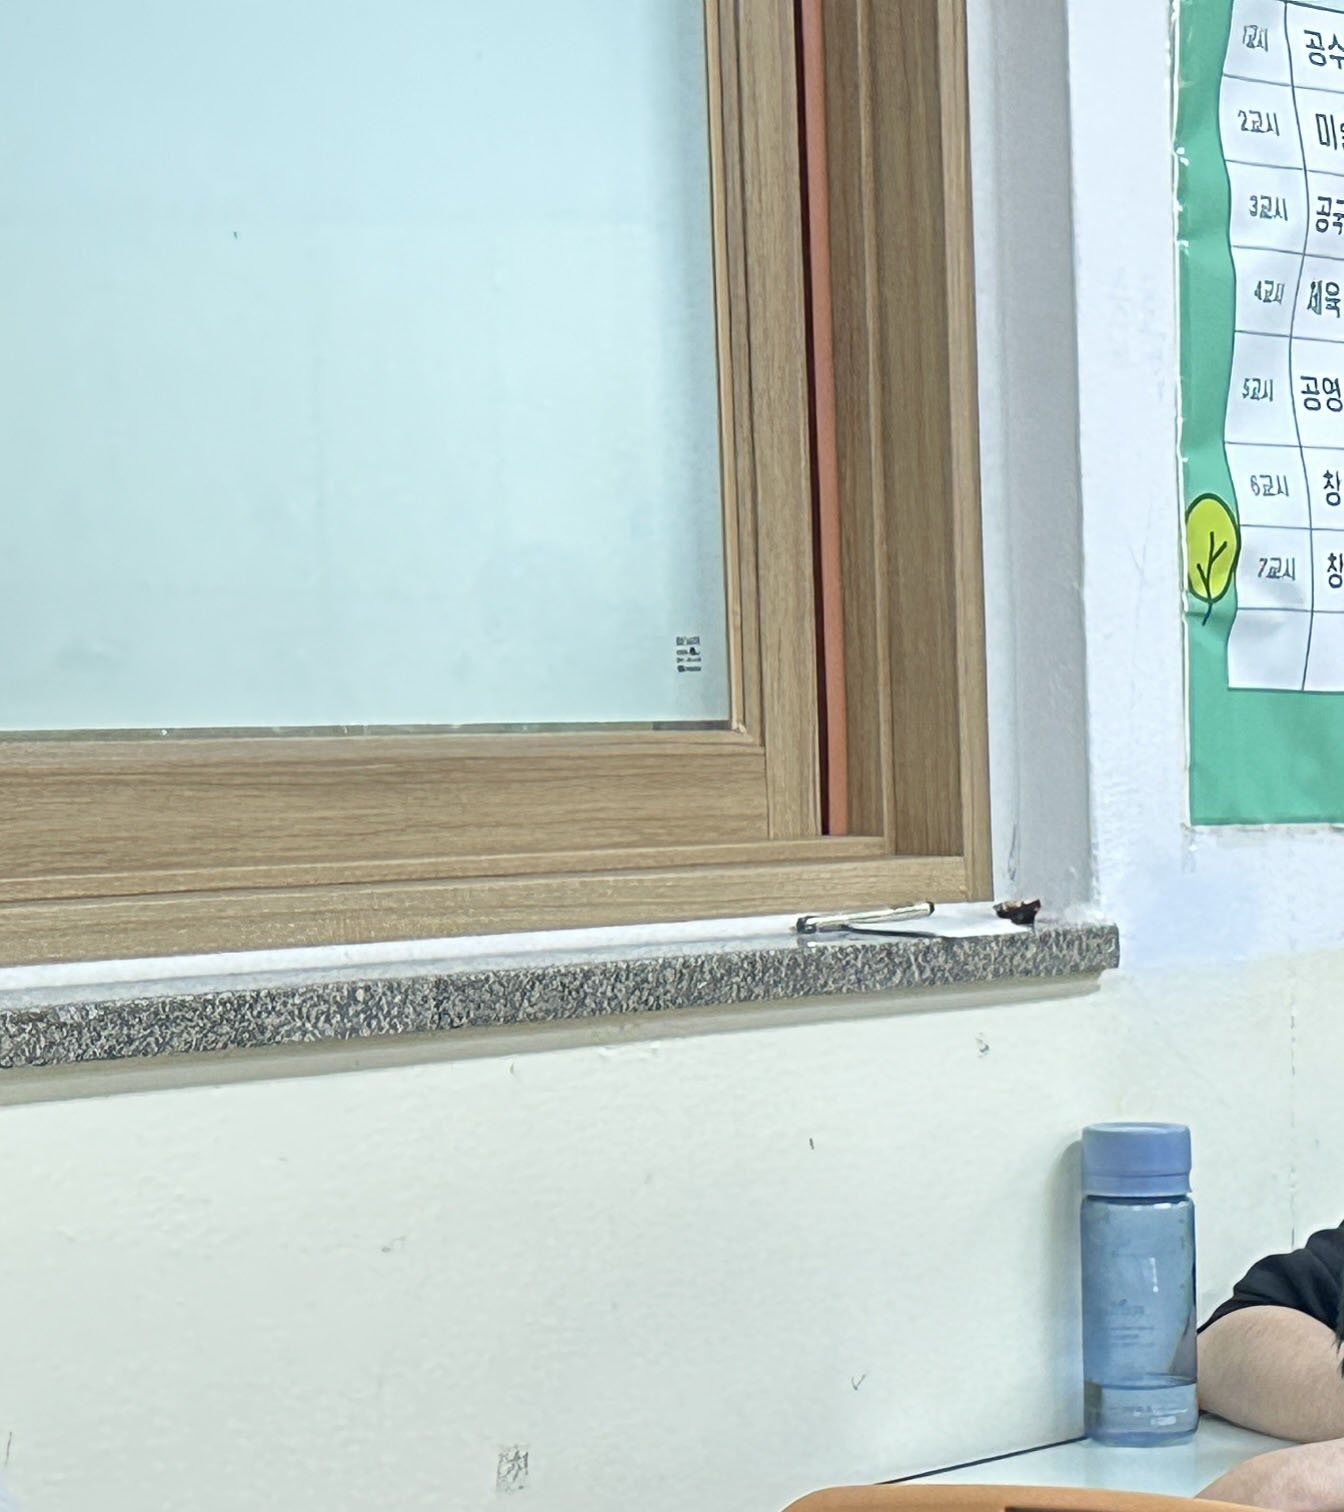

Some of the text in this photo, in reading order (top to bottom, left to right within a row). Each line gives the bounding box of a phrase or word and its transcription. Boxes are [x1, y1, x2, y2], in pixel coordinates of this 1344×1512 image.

[1237, 109, 1280, 136] 2교시
[1249, 195, 1288, 221] 3교시
[1242, 378, 1274, 402] 5교시
[1250, 474, 1290, 497] 6교시
[1257, 557, 1296, 580] 7교시
